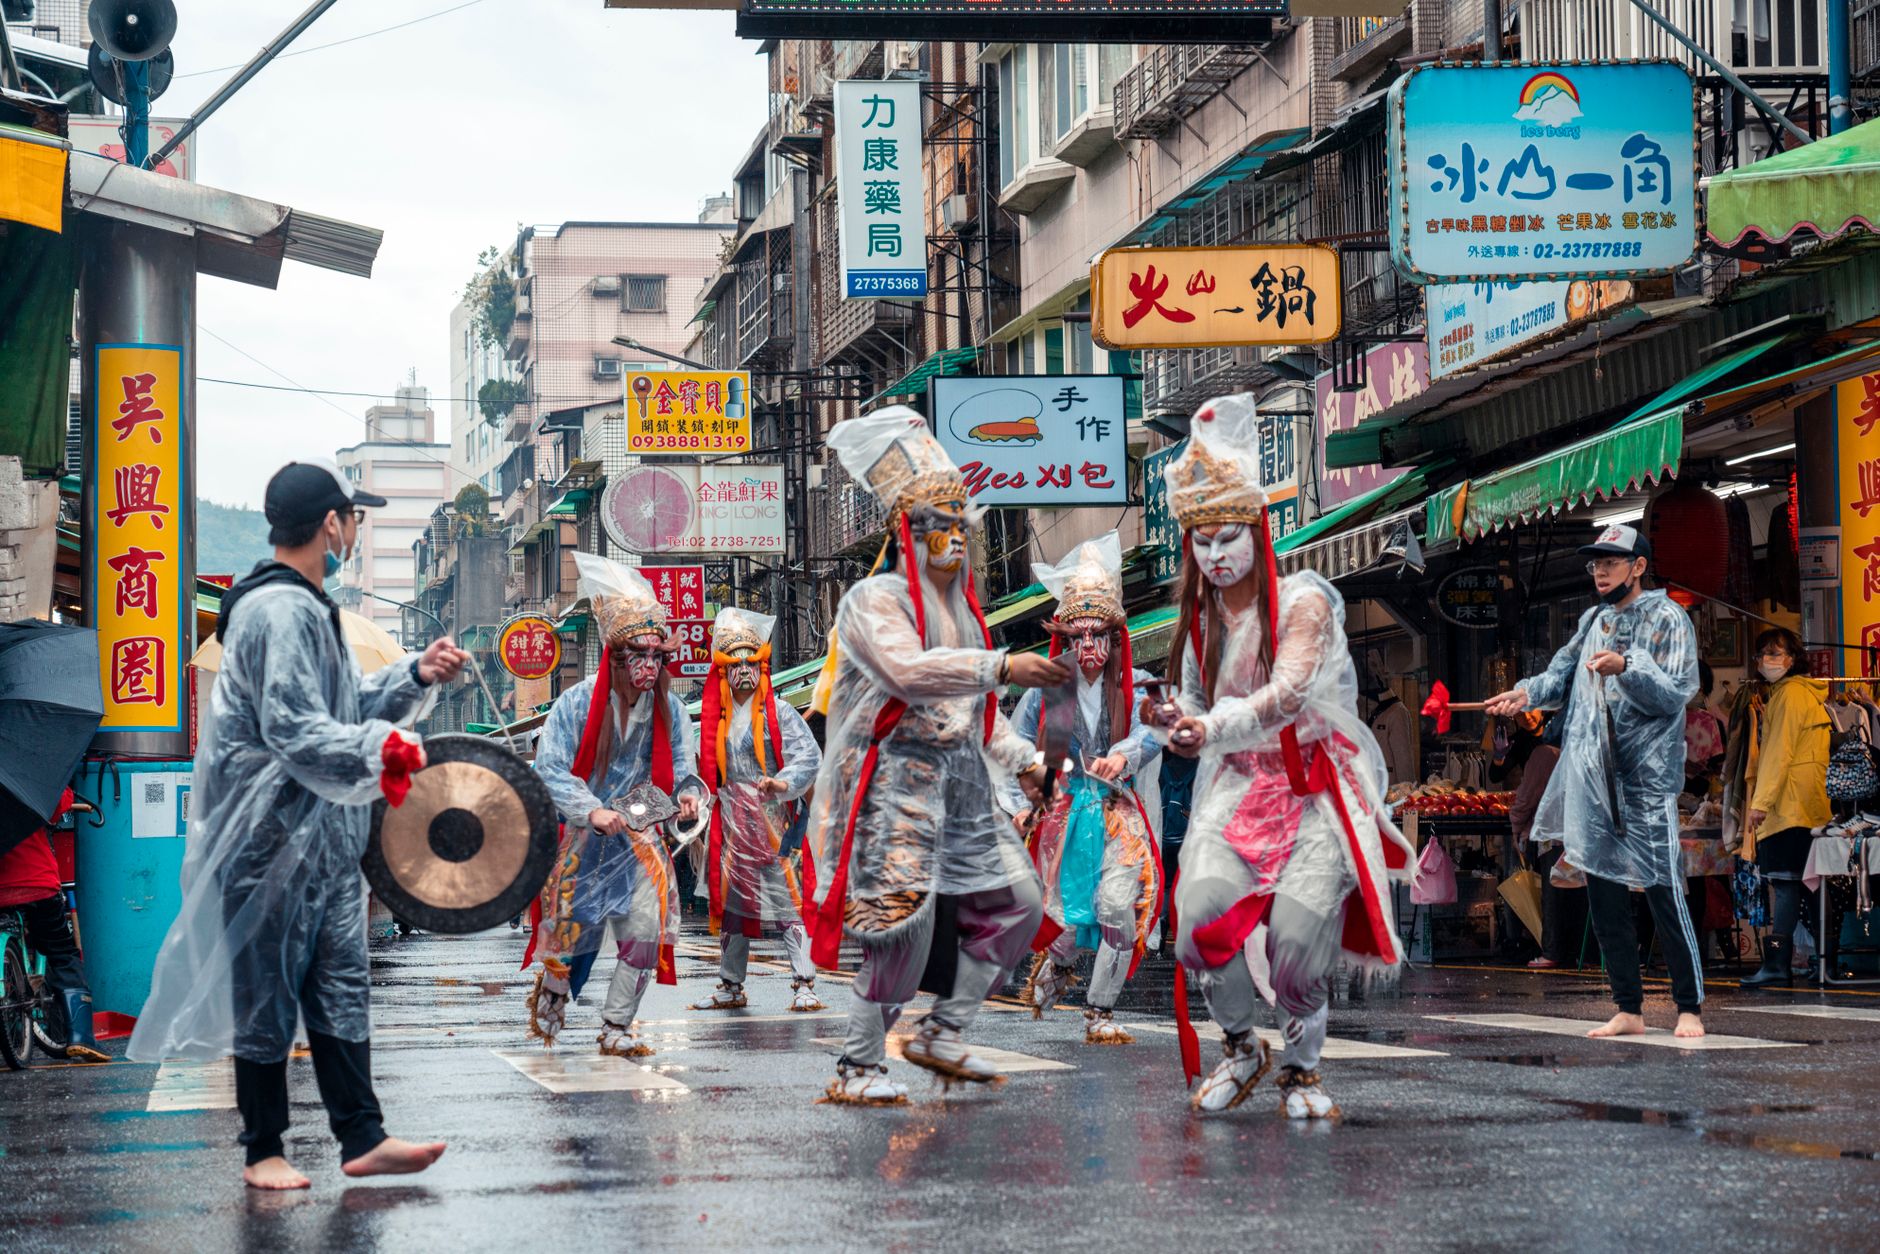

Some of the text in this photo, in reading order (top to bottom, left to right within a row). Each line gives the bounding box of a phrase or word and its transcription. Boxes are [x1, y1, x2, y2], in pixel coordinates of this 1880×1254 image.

[861, 94, 902, 257] 力康藥局
[1427, 133, 1672, 205] 冰山一角
[1557, 213, 1612, 231] 芒果冰
[1622, 211, 1677, 230] 雪花冰
[1533, 241, 1642, 259] 02-23787888
[854, 277, 919, 290] 27375368
[1122, 264, 1316, 329] 火山一鍋
[652, 379, 723, 415] 金寶貝
[1052, 386, 1111, 442] 手作
[632, 435, 746, 448] 0938881319
[696, 480, 779, 502] 金龍鮮果
[958, 461, 1115, 498] Yes 刈包
[699, 505, 728, 519] KING
[106, 373, 169, 706] 吳興商圈
[711, 535, 781, 547] 2738-7251
